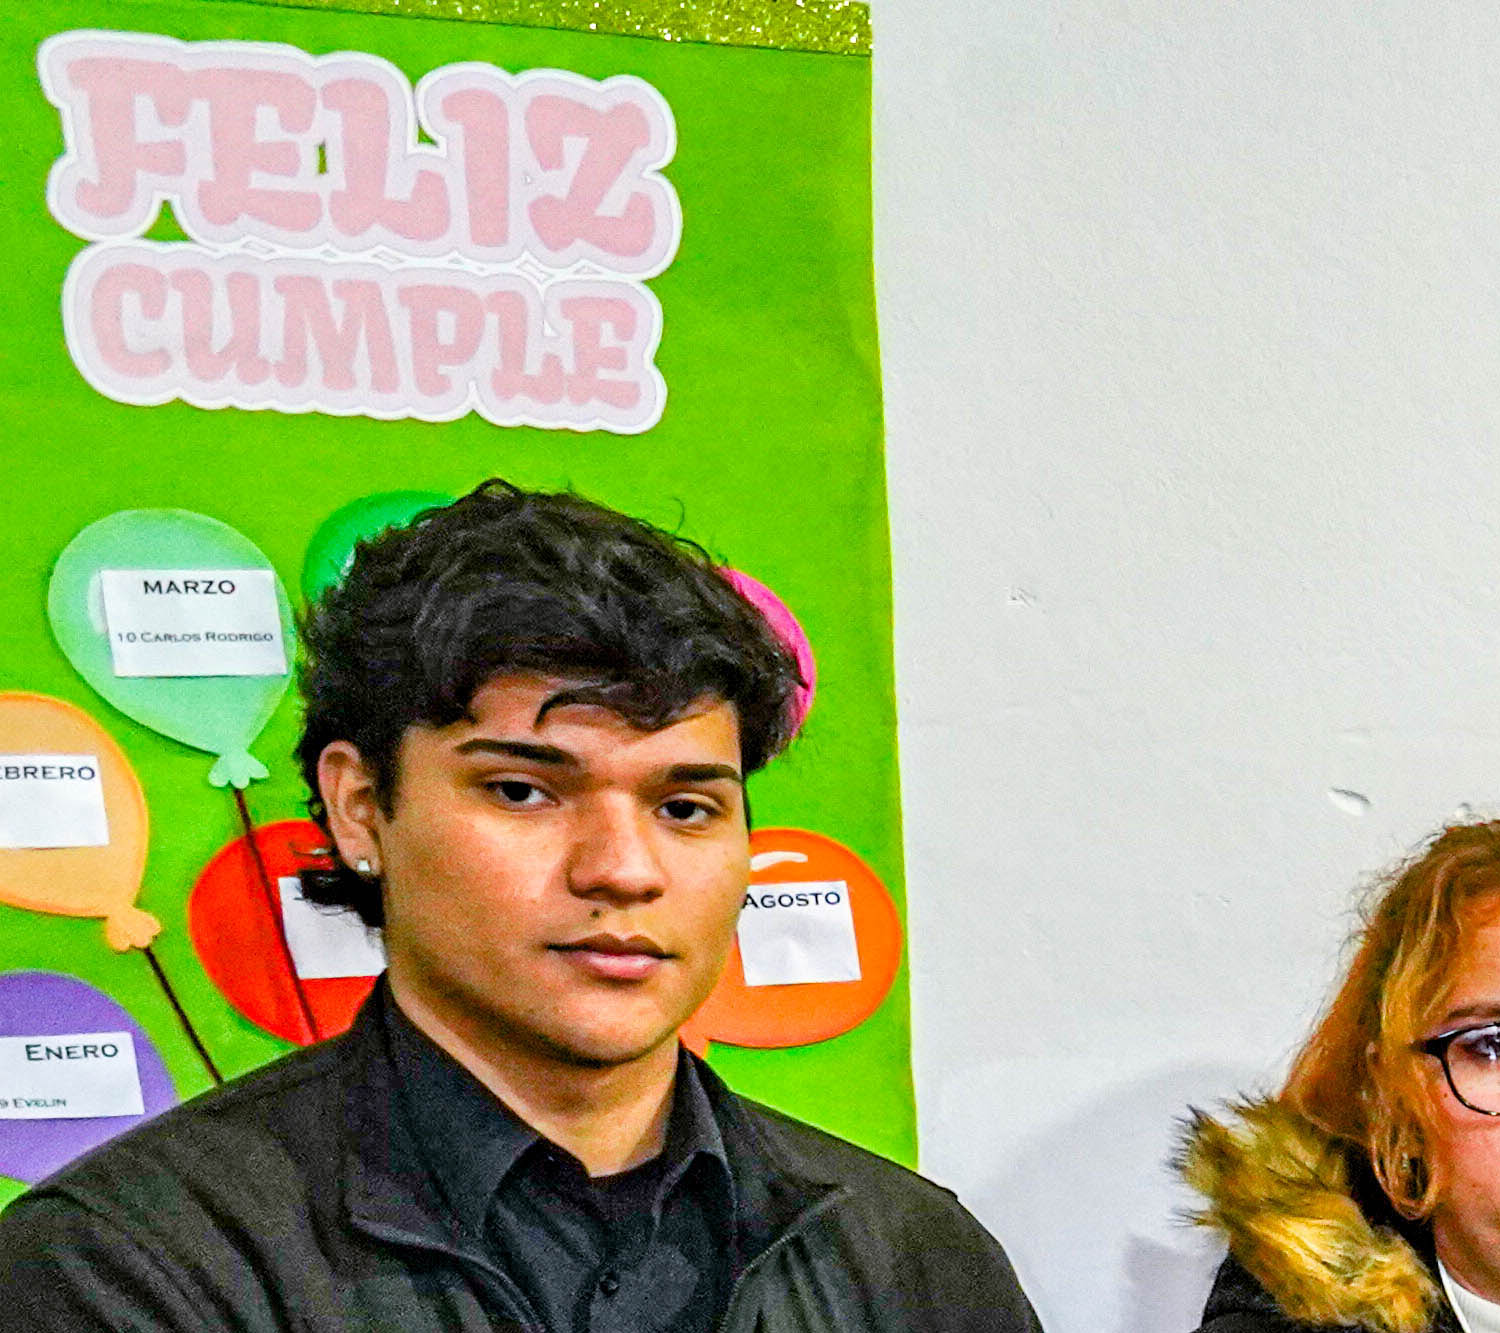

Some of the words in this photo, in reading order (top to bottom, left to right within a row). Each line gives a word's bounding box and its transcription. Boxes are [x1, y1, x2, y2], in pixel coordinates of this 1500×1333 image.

[66, 56, 657, 258] FELIZ
[90, 262, 643, 409] CUMPLE
[143, 579, 236, 595] MARZO
[117, 631, 137, 644] 10
[0, 765, 96, 781] BRERO
[741, 891, 841, 909] AGOSTO
[25, 1043, 119, 1061] ENERO
